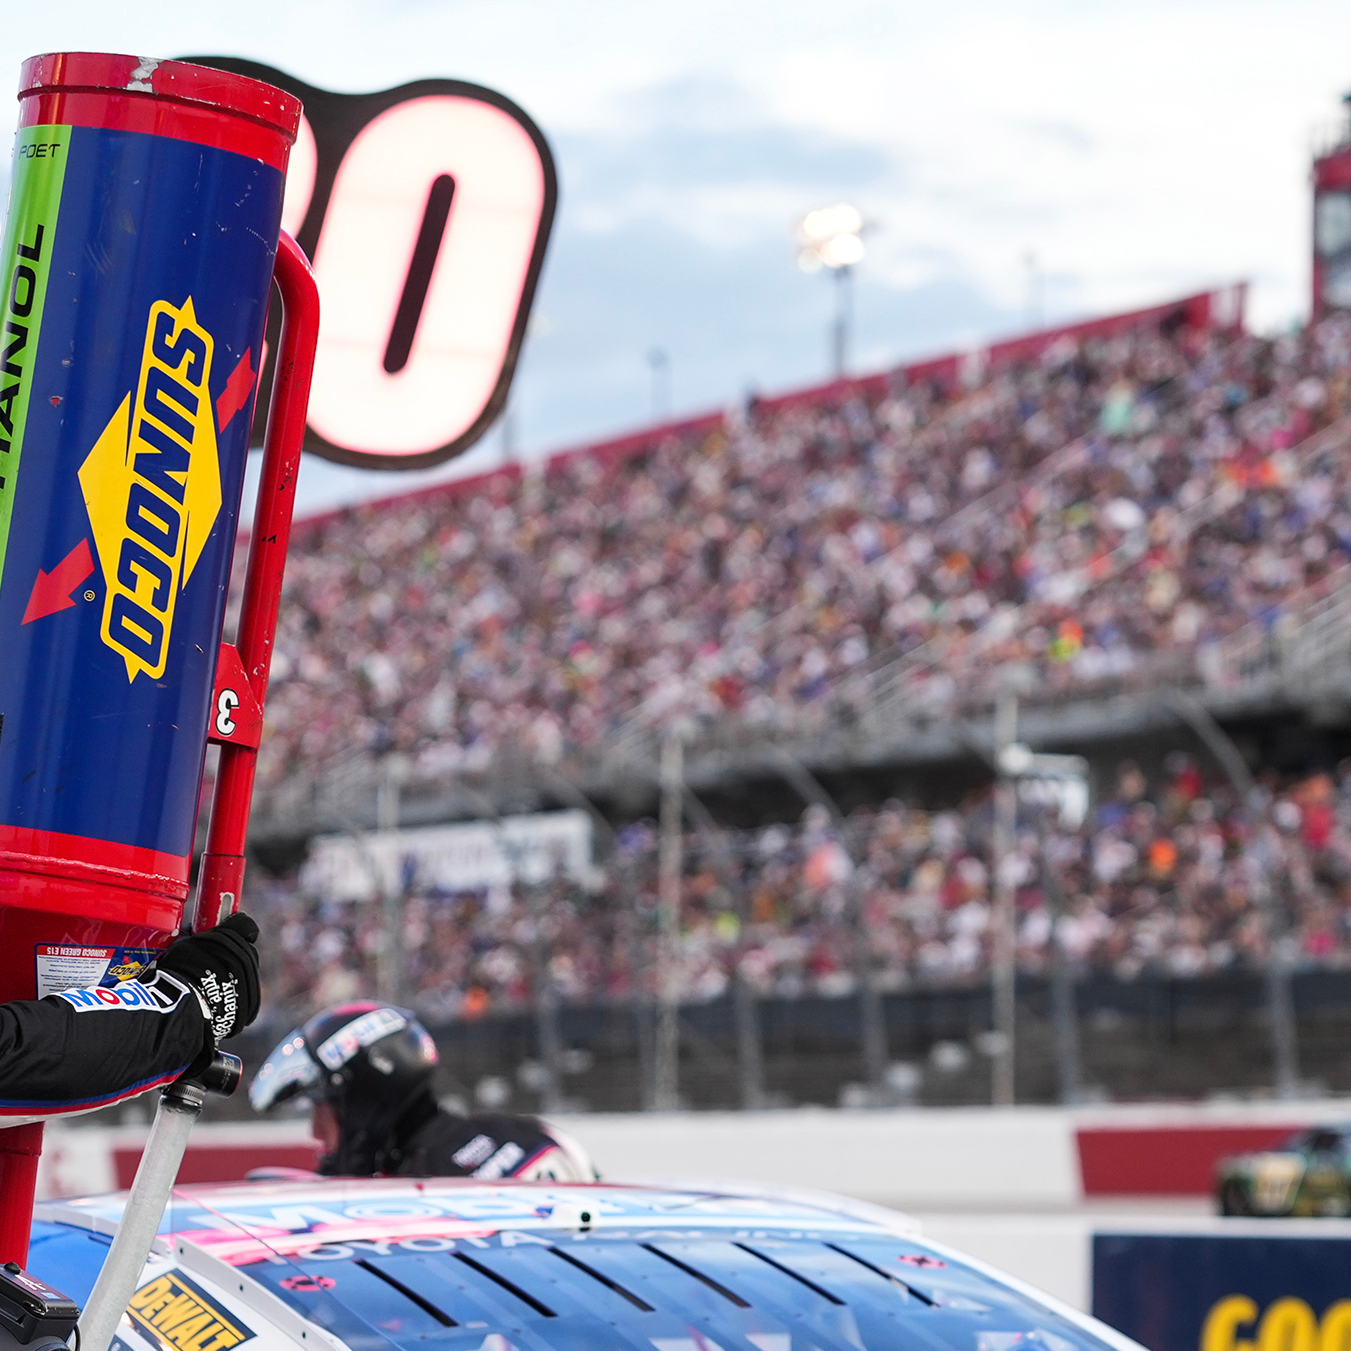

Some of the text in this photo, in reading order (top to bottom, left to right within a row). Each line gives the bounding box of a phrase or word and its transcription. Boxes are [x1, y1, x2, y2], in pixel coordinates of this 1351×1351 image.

[18, 143, 61, 160] POET
[263, 98, 547, 457] 0
[108, 310, 208, 669] SUNOCO
[60, 947, 82, 956] GREEN
[81, 949, 108, 957] SUNOCO
[62, 981, 158, 1008] Mobil
